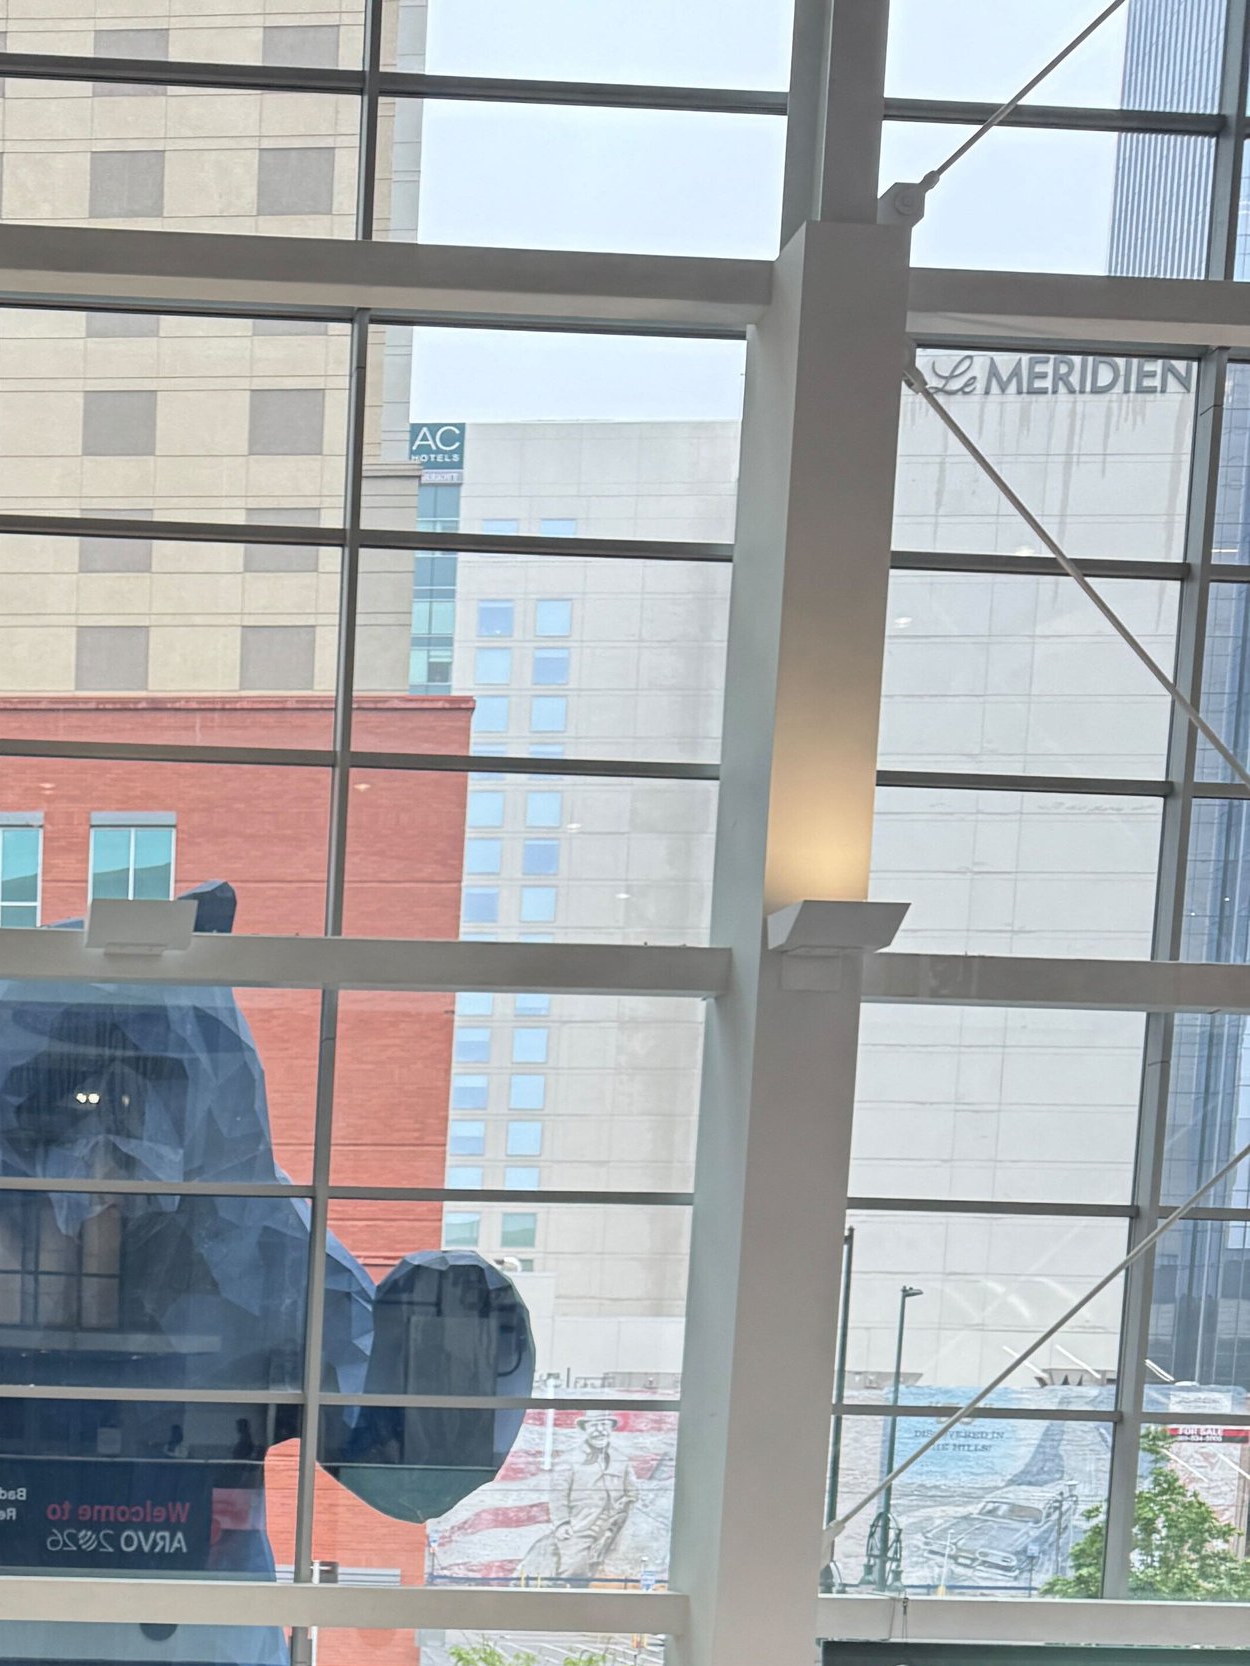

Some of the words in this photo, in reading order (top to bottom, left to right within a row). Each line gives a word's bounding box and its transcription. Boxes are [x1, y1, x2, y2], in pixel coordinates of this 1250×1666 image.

[926, 355, 979, 395] Le
[984, 357, 1196, 395] MERIDIEN
[411, 426, 461, 451] AC
[411, 453, 460, 463] HOTELS
